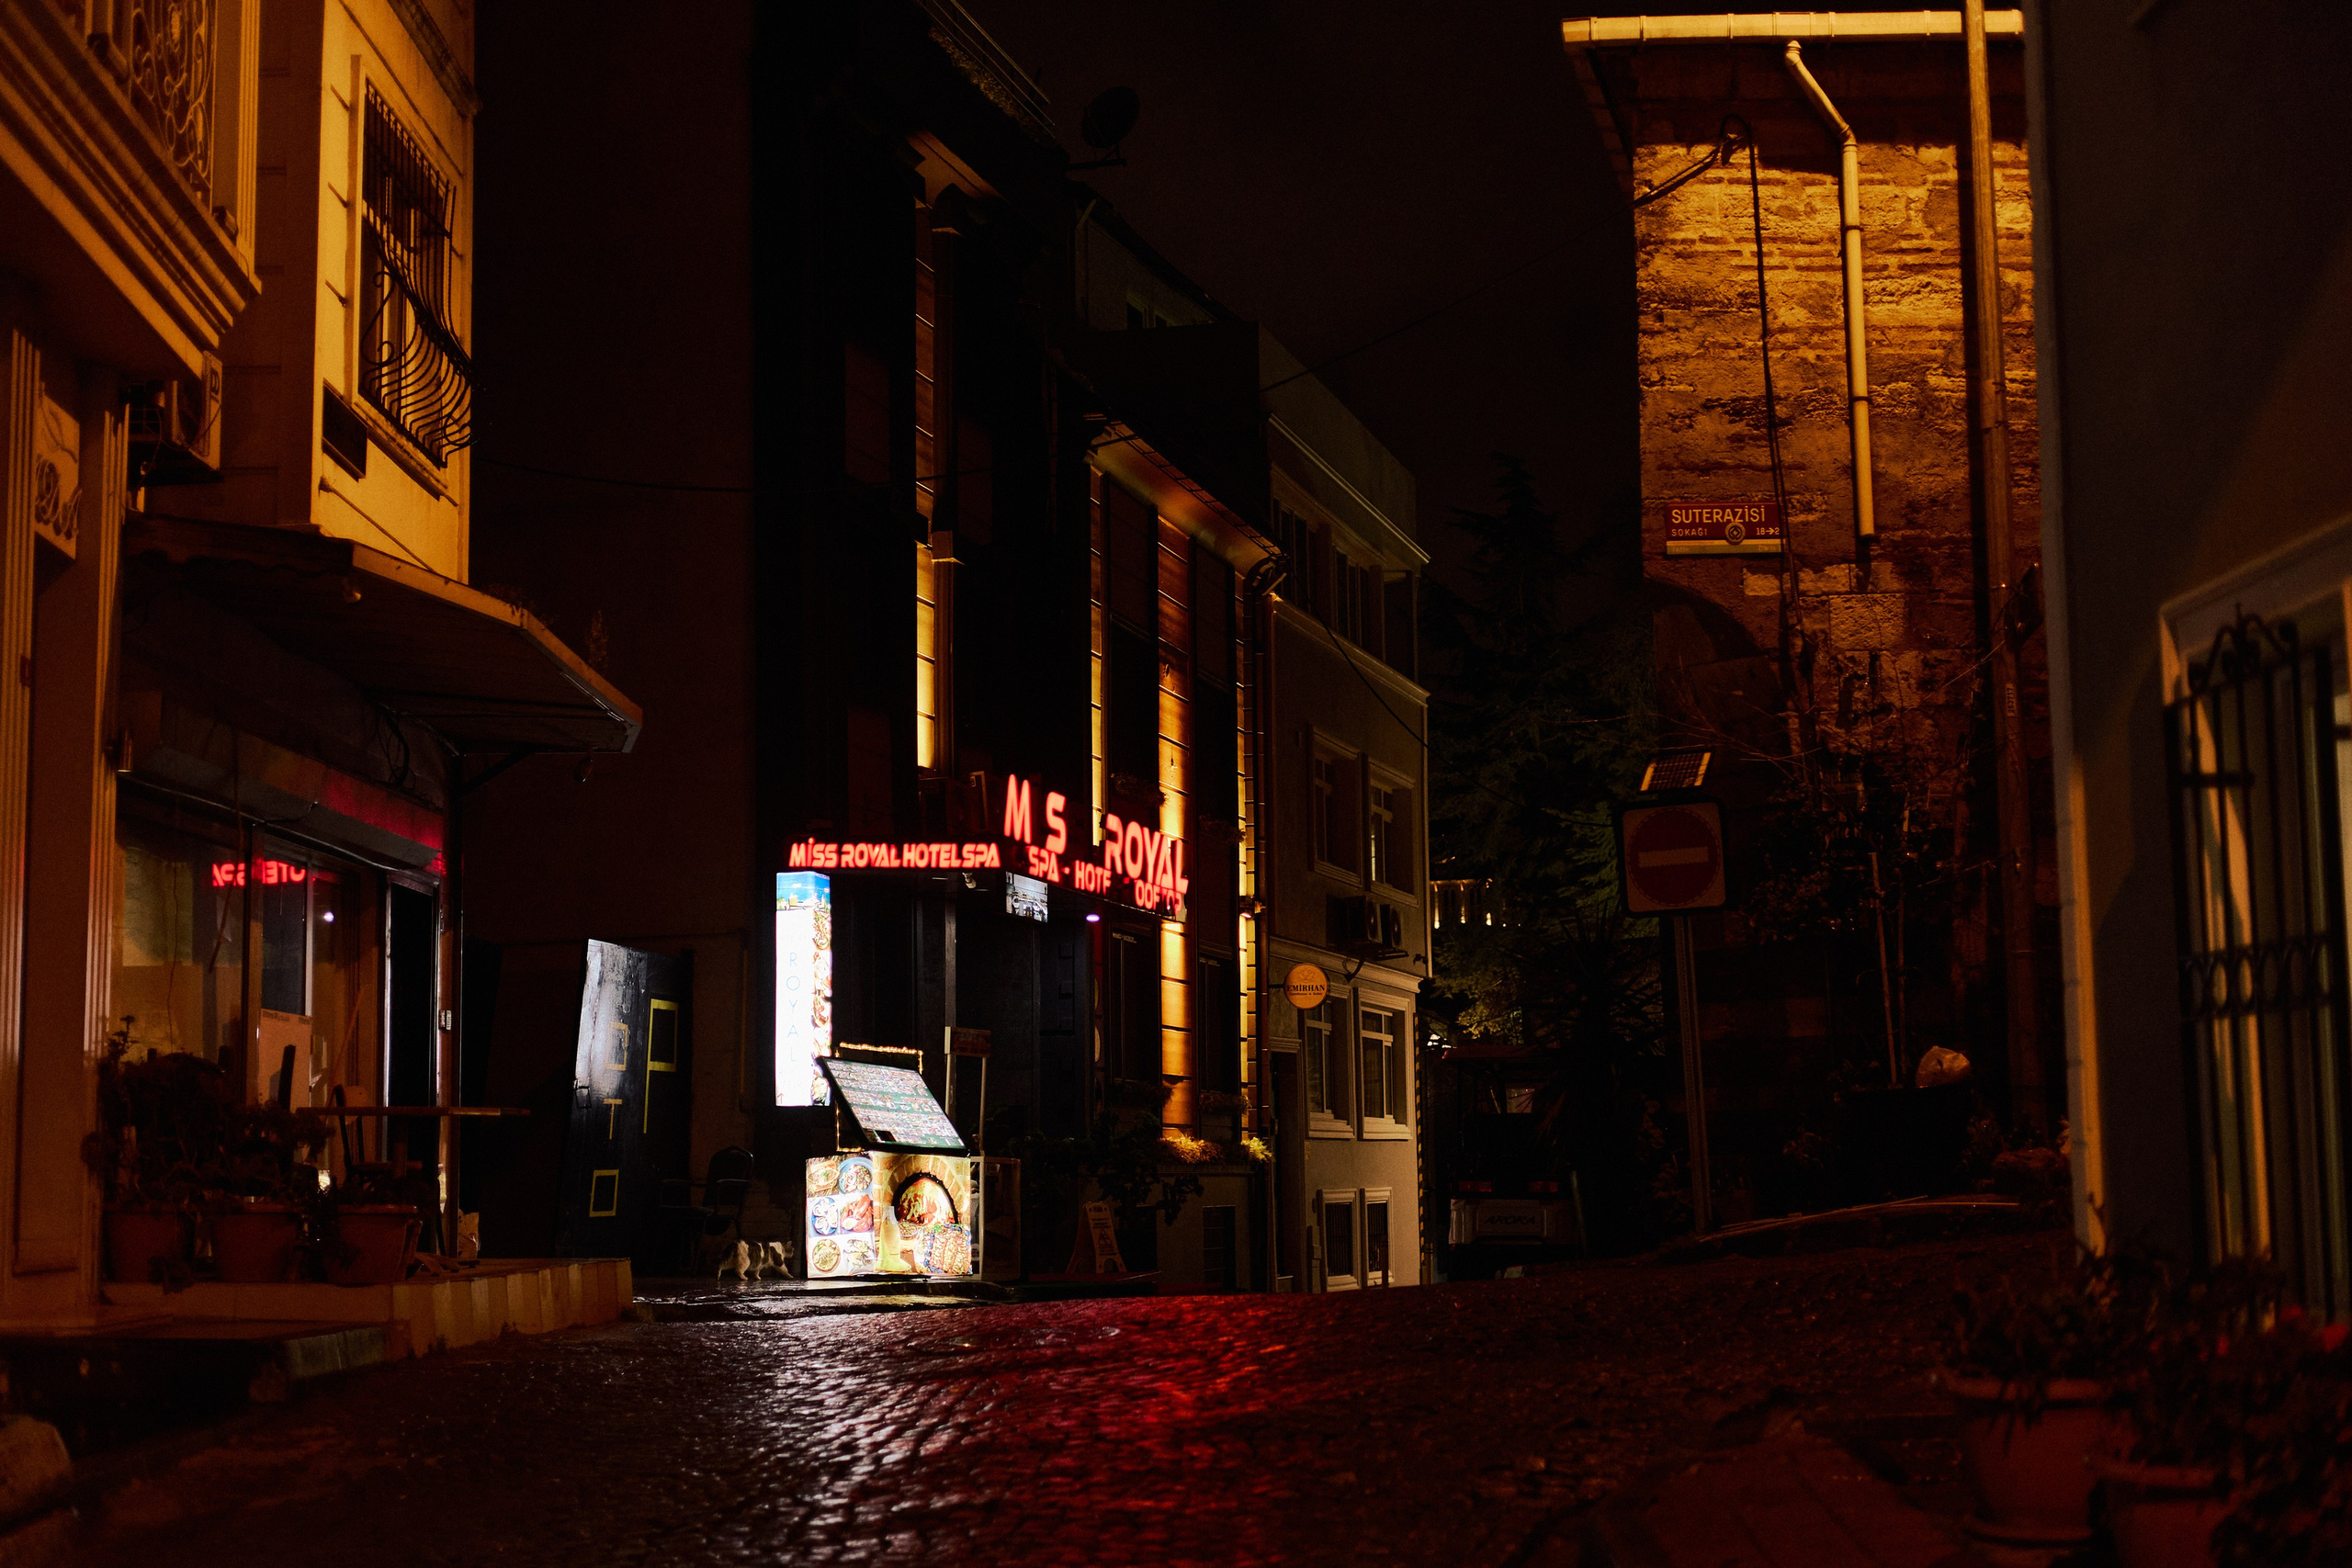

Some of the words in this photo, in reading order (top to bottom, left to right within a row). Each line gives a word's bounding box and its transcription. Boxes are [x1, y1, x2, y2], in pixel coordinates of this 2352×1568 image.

[1671, 505, 1766, 524] SUTERAZİSİ
[1671, 527, 1708, 536] SOKAĞI
[840, 842, 901, 868] ROYAL
[902, 842, 962, 868] HOTEL
[961, 842, 1001, 868] SPA
[1026, 845, 1060, 883] SPA
[1104, 813, 1189, 895] ROYAL
[786, 952, 801, 1062] ROYAL
[1484, 1214, 1536, 1225] ARORA
